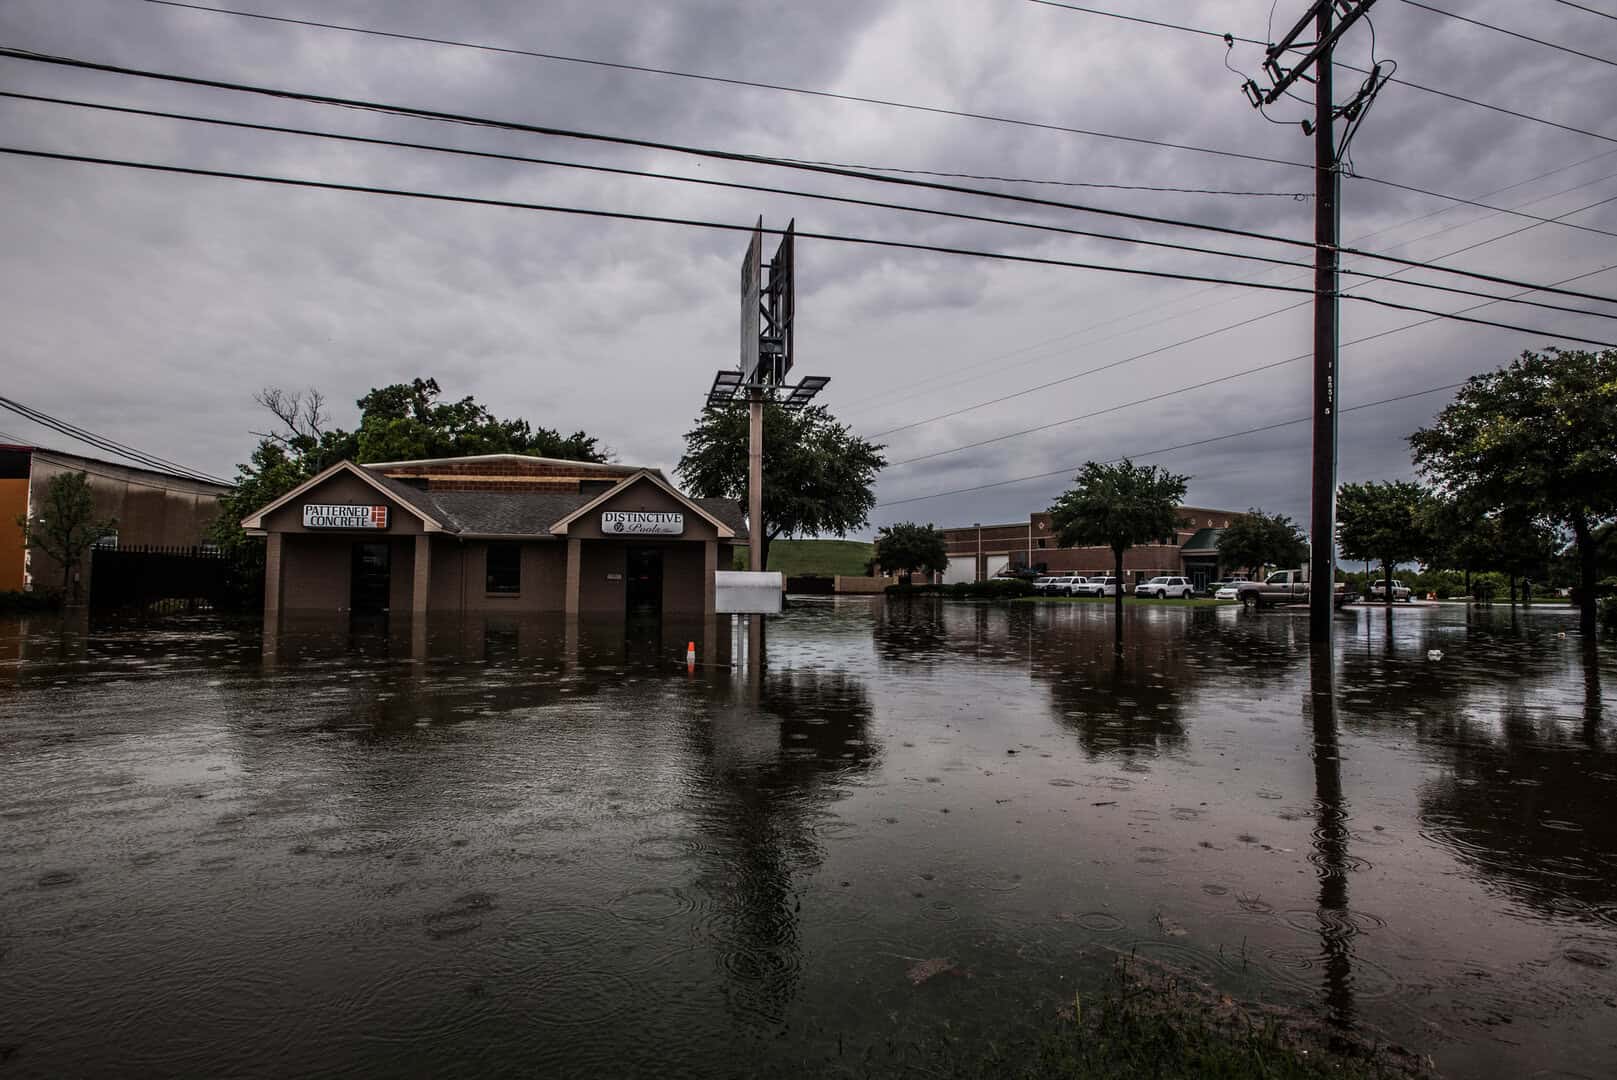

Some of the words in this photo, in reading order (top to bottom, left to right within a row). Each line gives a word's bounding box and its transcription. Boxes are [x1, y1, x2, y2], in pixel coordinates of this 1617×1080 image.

[305, 505, 369, 517] PATTERNED
[310, 516, 369, 527] CONCRETE
[604, 512, 682, 523] DISTINCTIVE
